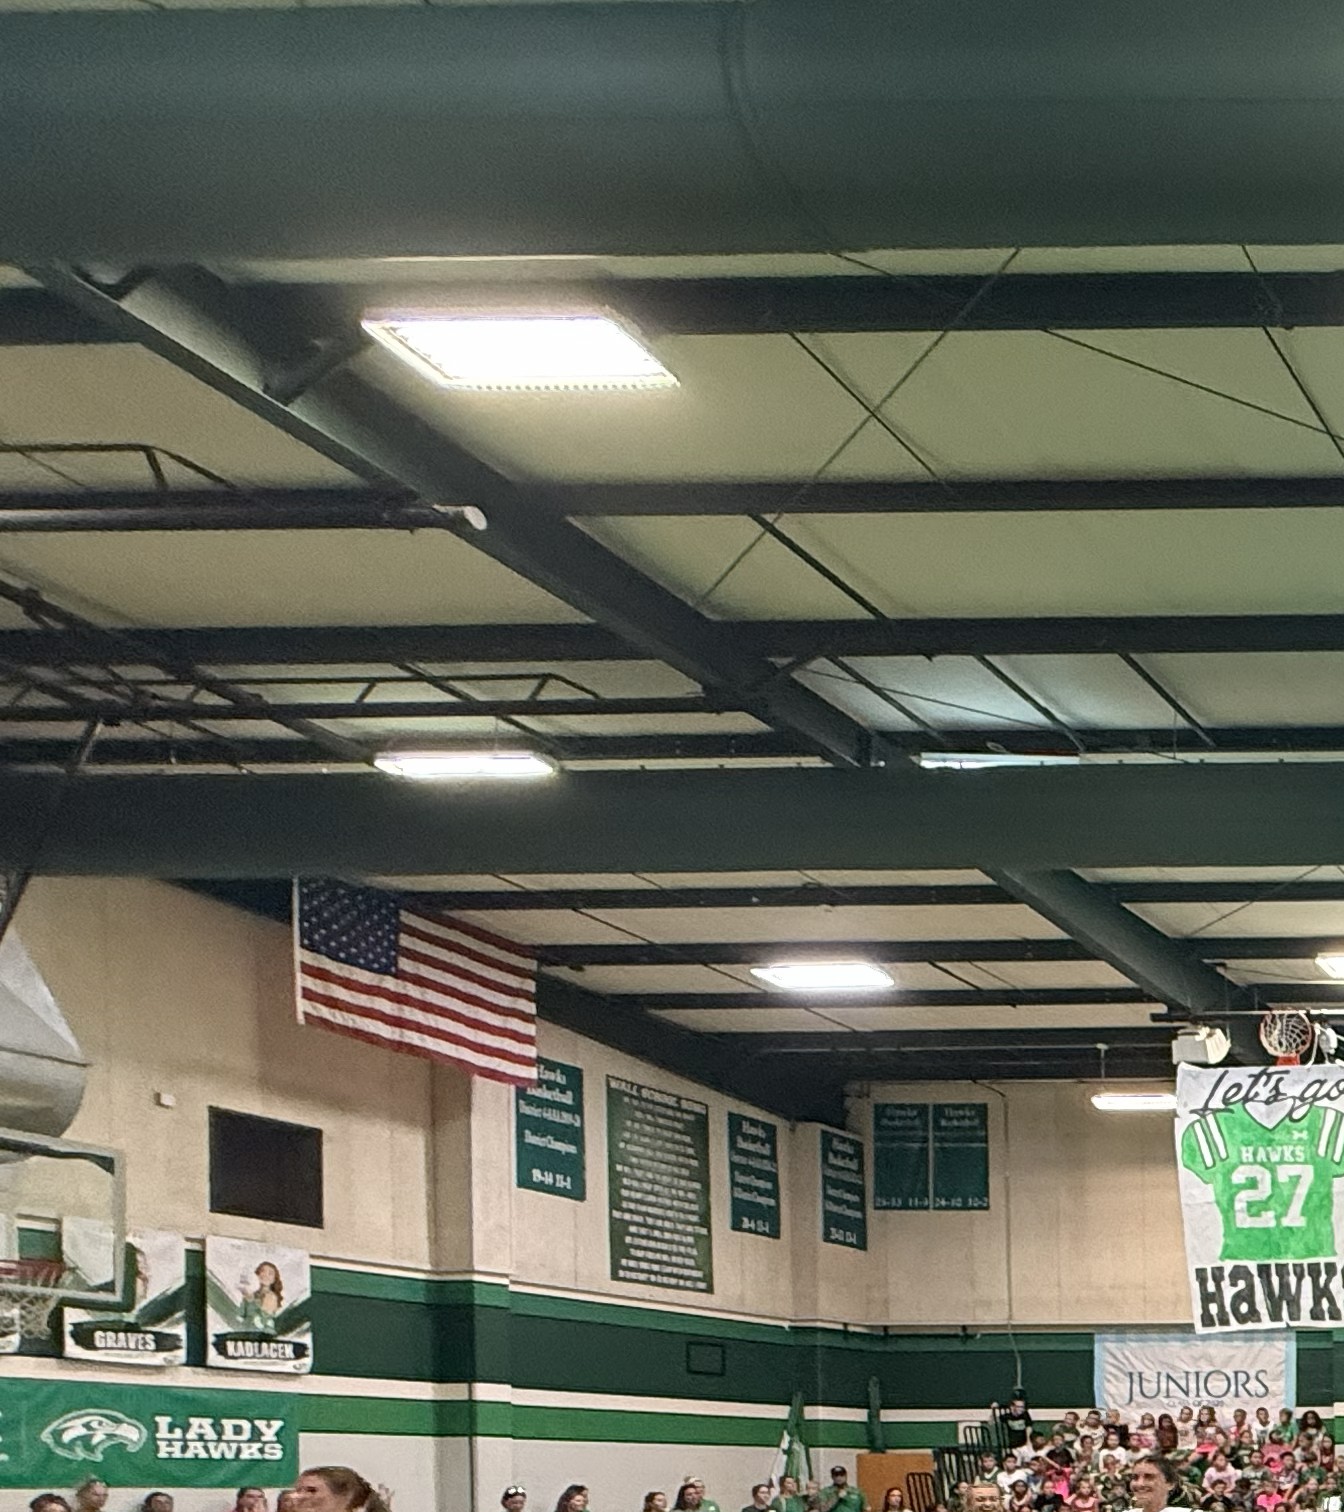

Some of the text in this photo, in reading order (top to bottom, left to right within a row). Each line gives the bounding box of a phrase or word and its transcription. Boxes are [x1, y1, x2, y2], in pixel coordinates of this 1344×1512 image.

[1190, 1069, 1291, 1115] Let's
[1240, 1145, 1305, 1162] HAWKS
[1231, 1164, 1314, 1228] 27
[93, 1330, 156, 1351] GRAVES
[1122, 1370, 1270, 1406] JUNIORS
[154, 1415, 285, 1442] LADY
[156, 1440, 284, 1461] HAWKS
